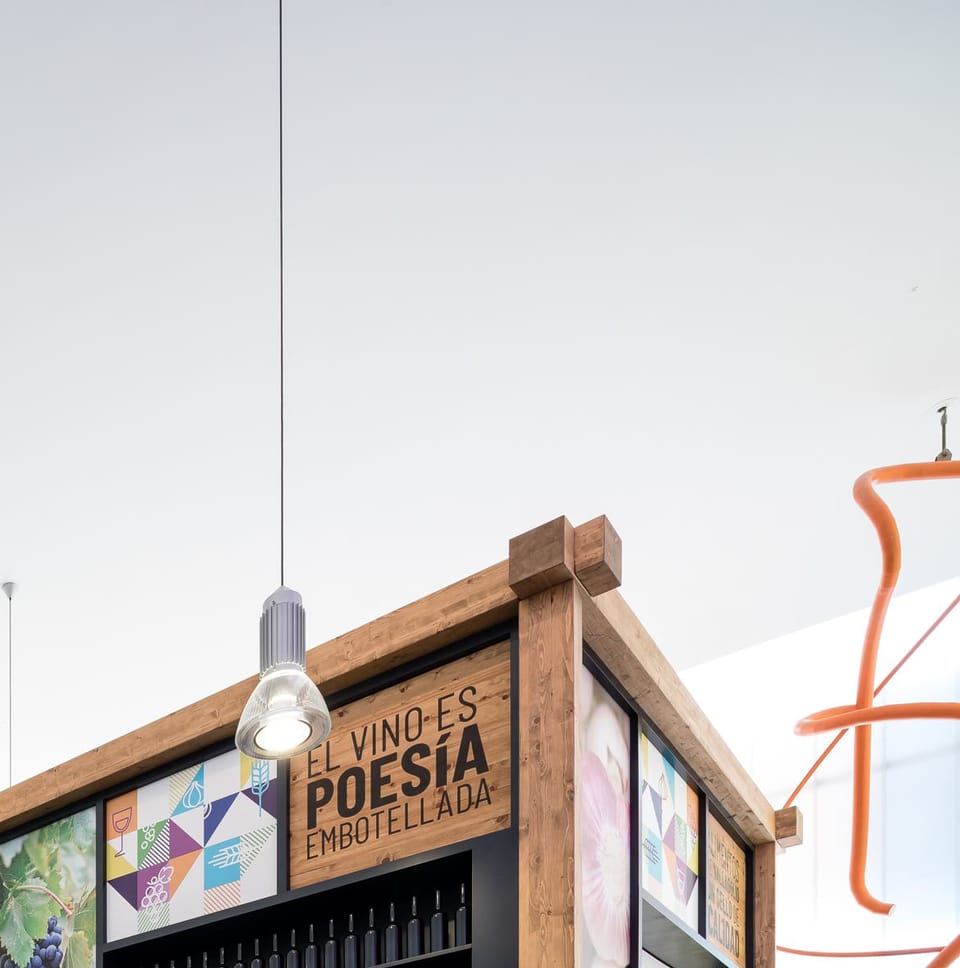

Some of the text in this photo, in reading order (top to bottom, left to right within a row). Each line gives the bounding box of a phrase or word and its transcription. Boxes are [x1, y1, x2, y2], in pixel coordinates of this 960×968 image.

[307, 724, 489, 830] POESÍA
[308, 686, 477, 778] EL VINO ES
[307, 778, 492, 860] EMBOTELLADA
